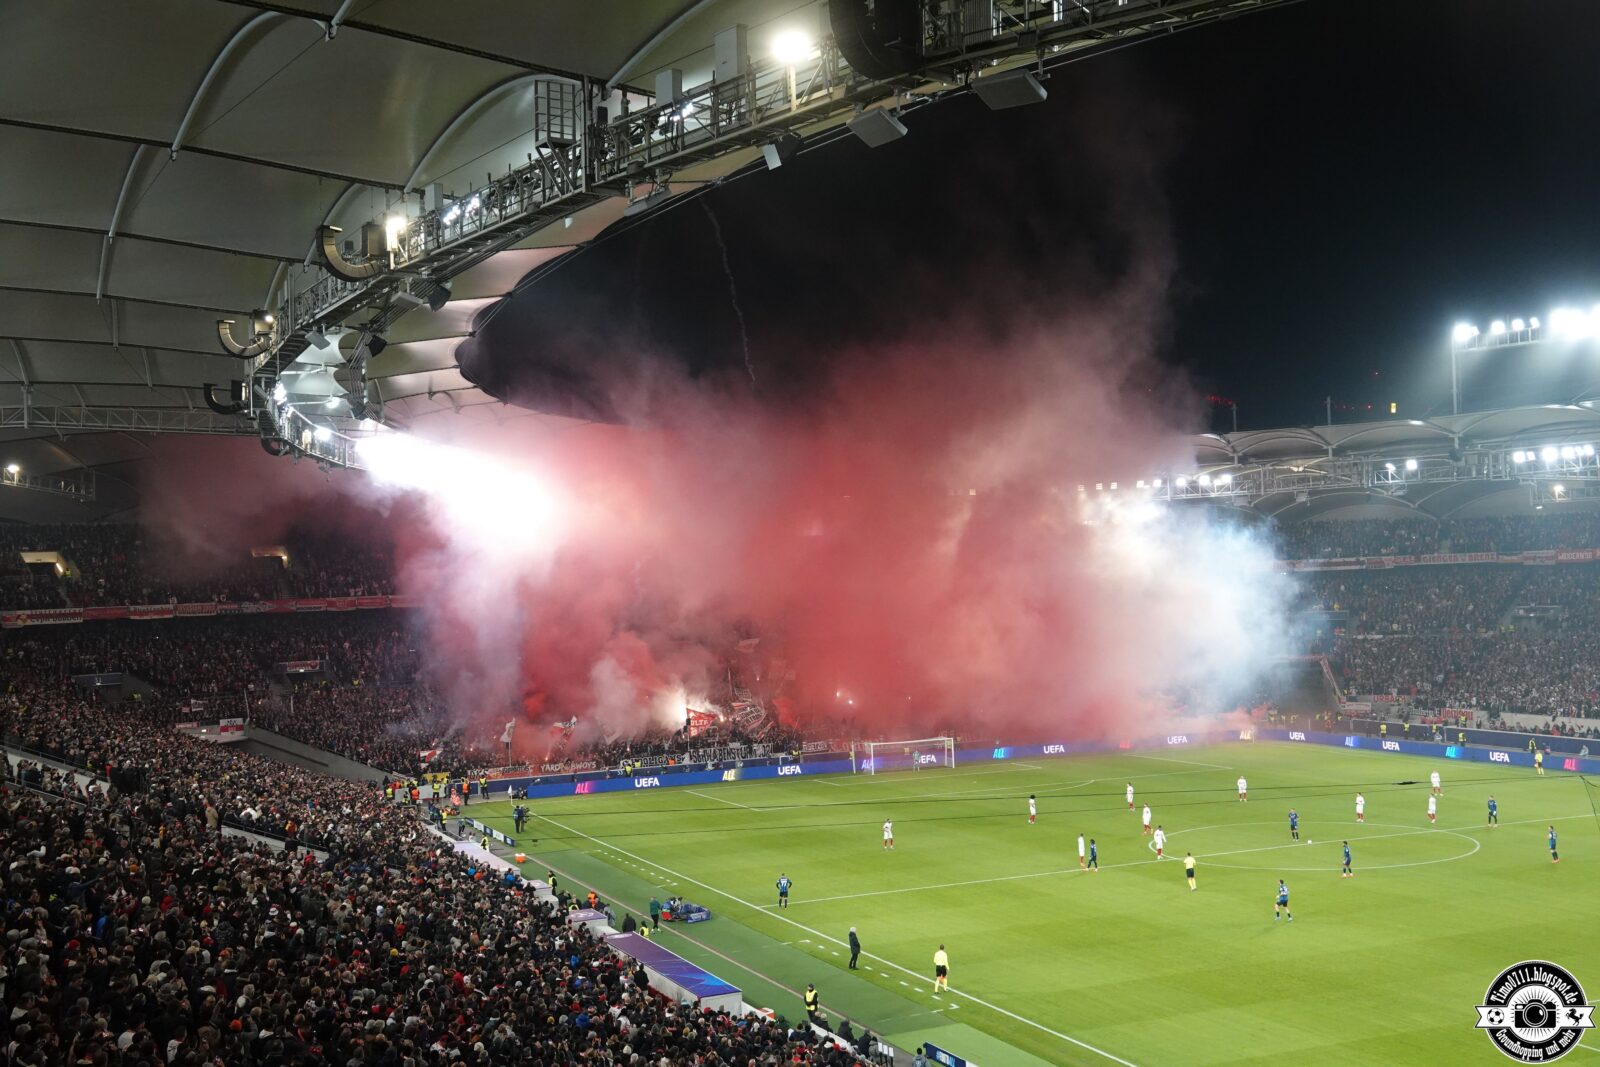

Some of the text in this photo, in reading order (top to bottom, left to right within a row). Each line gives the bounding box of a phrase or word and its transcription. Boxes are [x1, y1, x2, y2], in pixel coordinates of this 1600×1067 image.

[1167, 735, 1188, 745] UEFA
[1289, 731, 1306, 741] UEFA
[1344, 736, 1354, 747] ALL
[1043, 744, 1065, 754] UEFA
[1382, 740, 1401, 751] UEFA
[1445, 746, 1457, 758] ALL
[1489, 751, 1510, 763] UEFA
[777, 764, 802, 776] UEFA
[1563, 758, 1577, 771] ALL
[722, 769, 736, 781] ALL
[575, 782, 589, 794] ALL
[634, 776, 660, 788] UEFA
